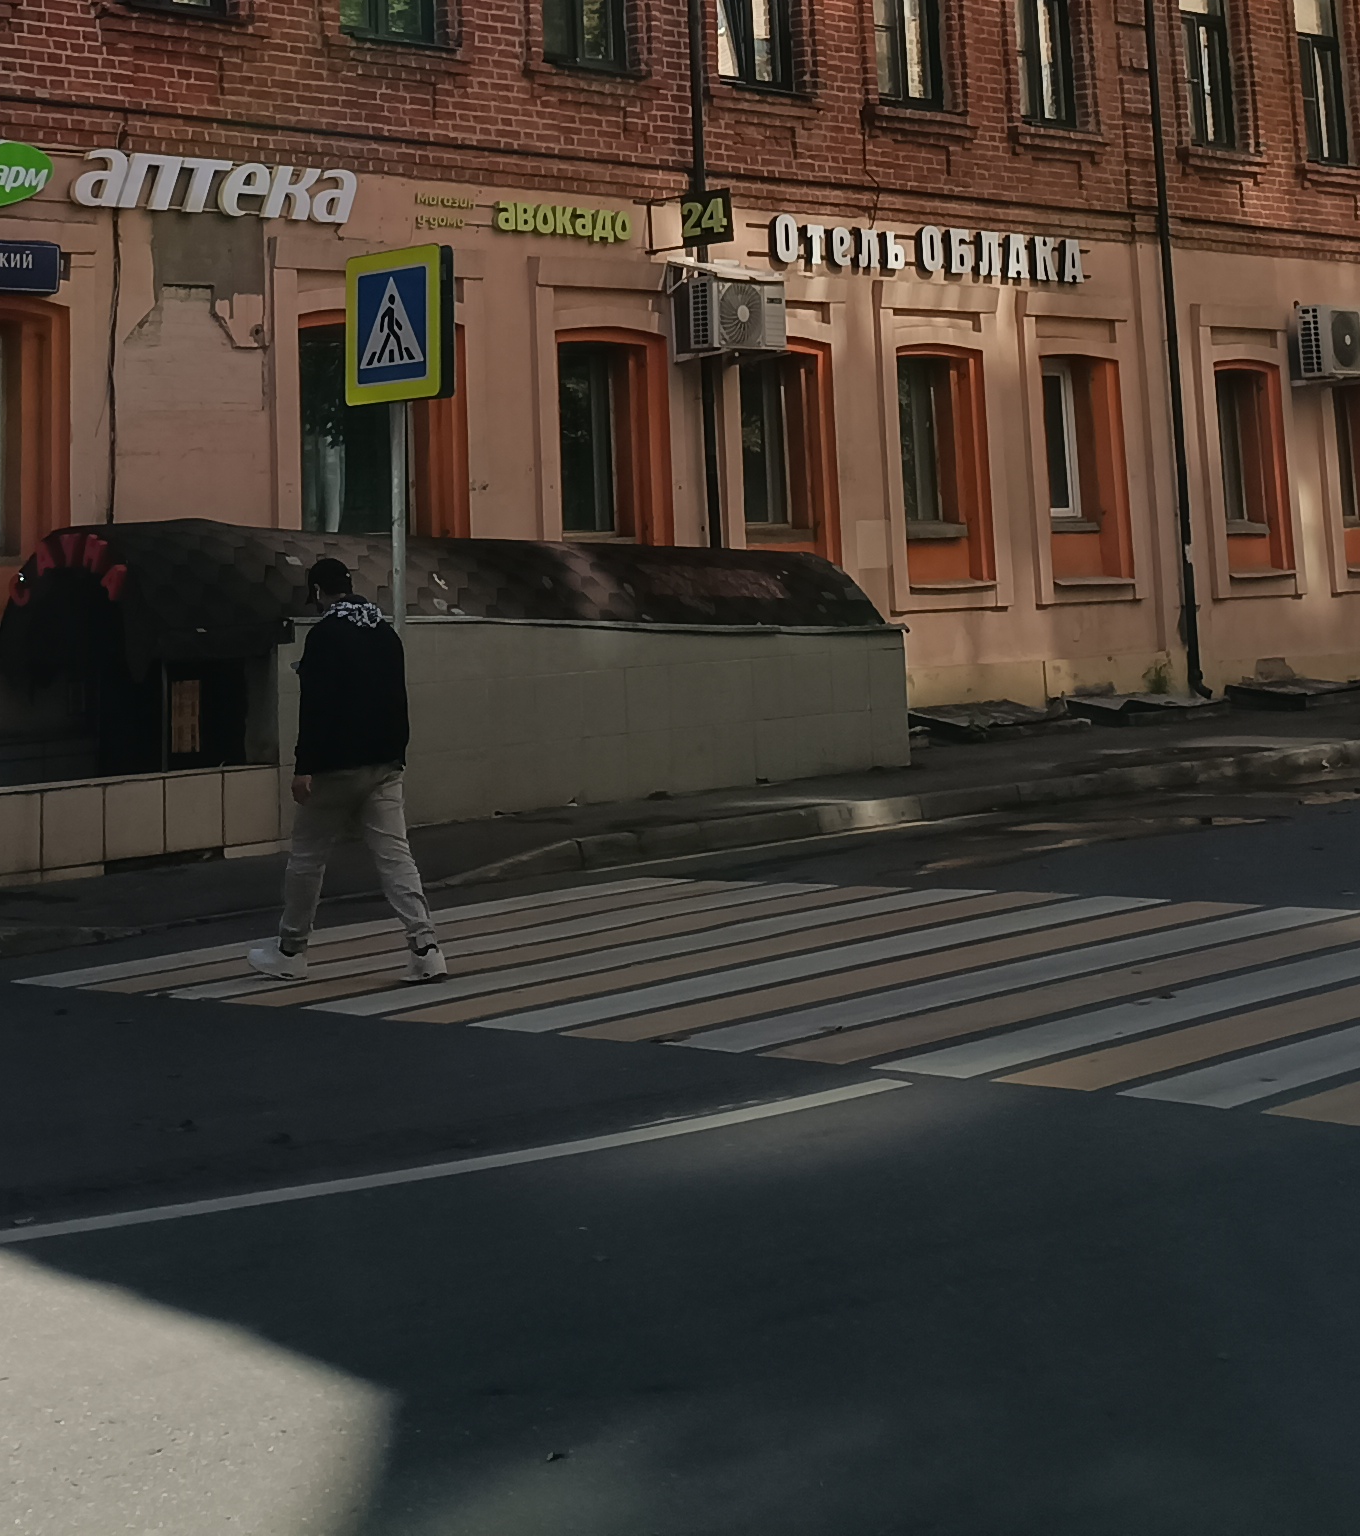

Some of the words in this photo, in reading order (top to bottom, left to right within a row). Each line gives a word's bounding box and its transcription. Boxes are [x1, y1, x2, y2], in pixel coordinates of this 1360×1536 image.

[71, 149, 358, 225] аптека
[496, 200, 633, 244] авокадо
[681, 196, 728, 238] 24
[773, 213, 906, 271] Отель
[920, 225, 1086, 284] ОБЛАКА
